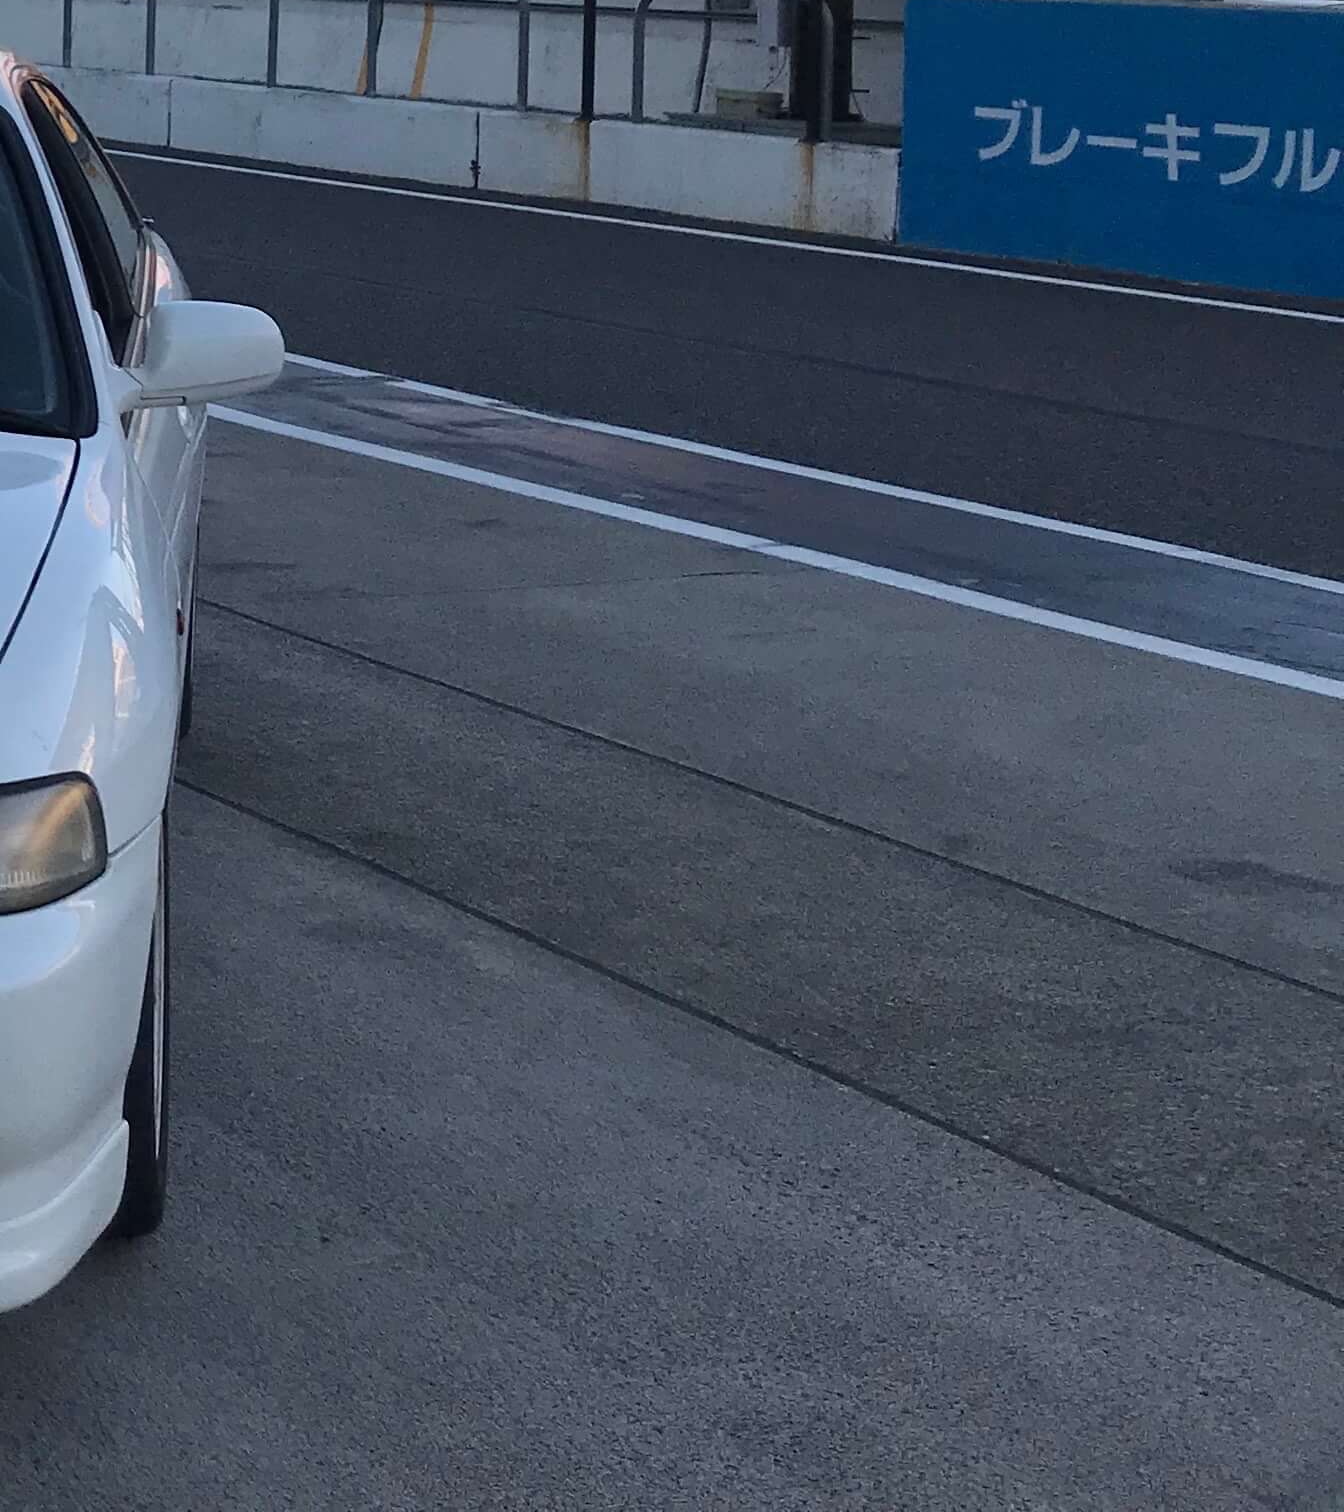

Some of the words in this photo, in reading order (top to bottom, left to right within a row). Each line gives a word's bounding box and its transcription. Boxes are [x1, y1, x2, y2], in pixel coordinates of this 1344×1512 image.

[975, 99, 1342, 192] ブレーキフル
